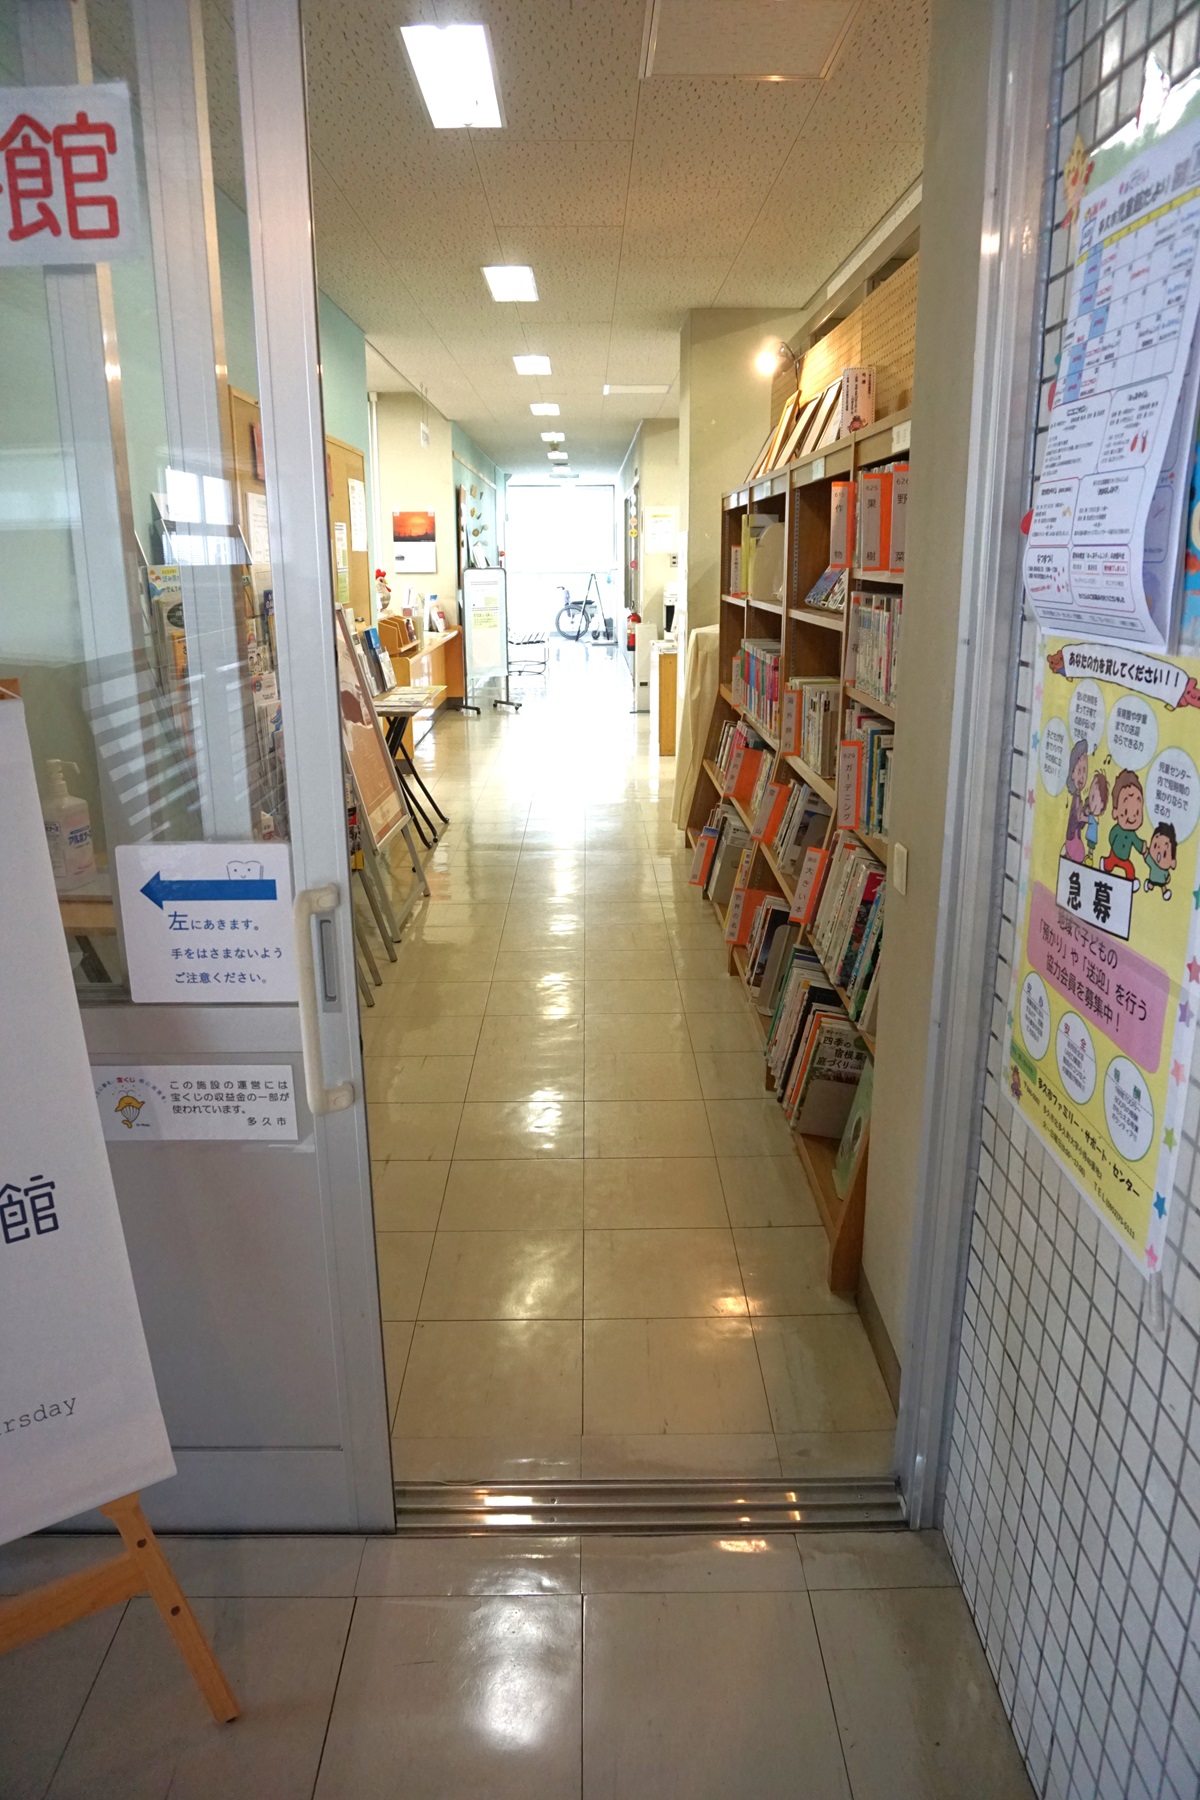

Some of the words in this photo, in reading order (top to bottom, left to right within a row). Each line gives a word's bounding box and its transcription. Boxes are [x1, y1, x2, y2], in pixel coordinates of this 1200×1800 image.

[0, 111, 120, 241] 館
[866, 498, 877, 562] 果樹
[1068, 652, 1180, 688] あなたの力を貸してください！！
[1114, 721, 1142, 738] までの送迎
[1113, 733, 1145, 753] ならできる方
[1158, 761, 1192, 780] 児童センター
[843, 764, 853, 821] ガーデニング
[1156, 776, 1191, 797] 内で短時間の
[1154, 803, 1171, 819] きる方
[795, 865, 814, 913] 大きい本
[1066, 871, 1114, 924] 急募
[168, 911, 259, 931] 左にあきます。
[1056, 908, 1118, 970] 地域で子どもの
[171, 947, 283, 960] 手をはさまないよう
[174, 972, 268, 984] ご注意ください。
[1039, 917, 1147, 1022] 「預かり」や「送迎」を行う
[1045, 951, 1121, 1033] 協力会員を募集中！
[816, 1056, 849, 1069] 庭づくり
[169, 1080, 289, 1091] この施設の運営には
[170, 1092, 290, 1102] 宝くじの収益金の一部が
[172, 1104, 247, 1115] 使われています。
[247, 1117, 287, 1127] 多久市
[0, 1174, 60, 1244] 館
[0, 1397, 76, 1436] rsday
